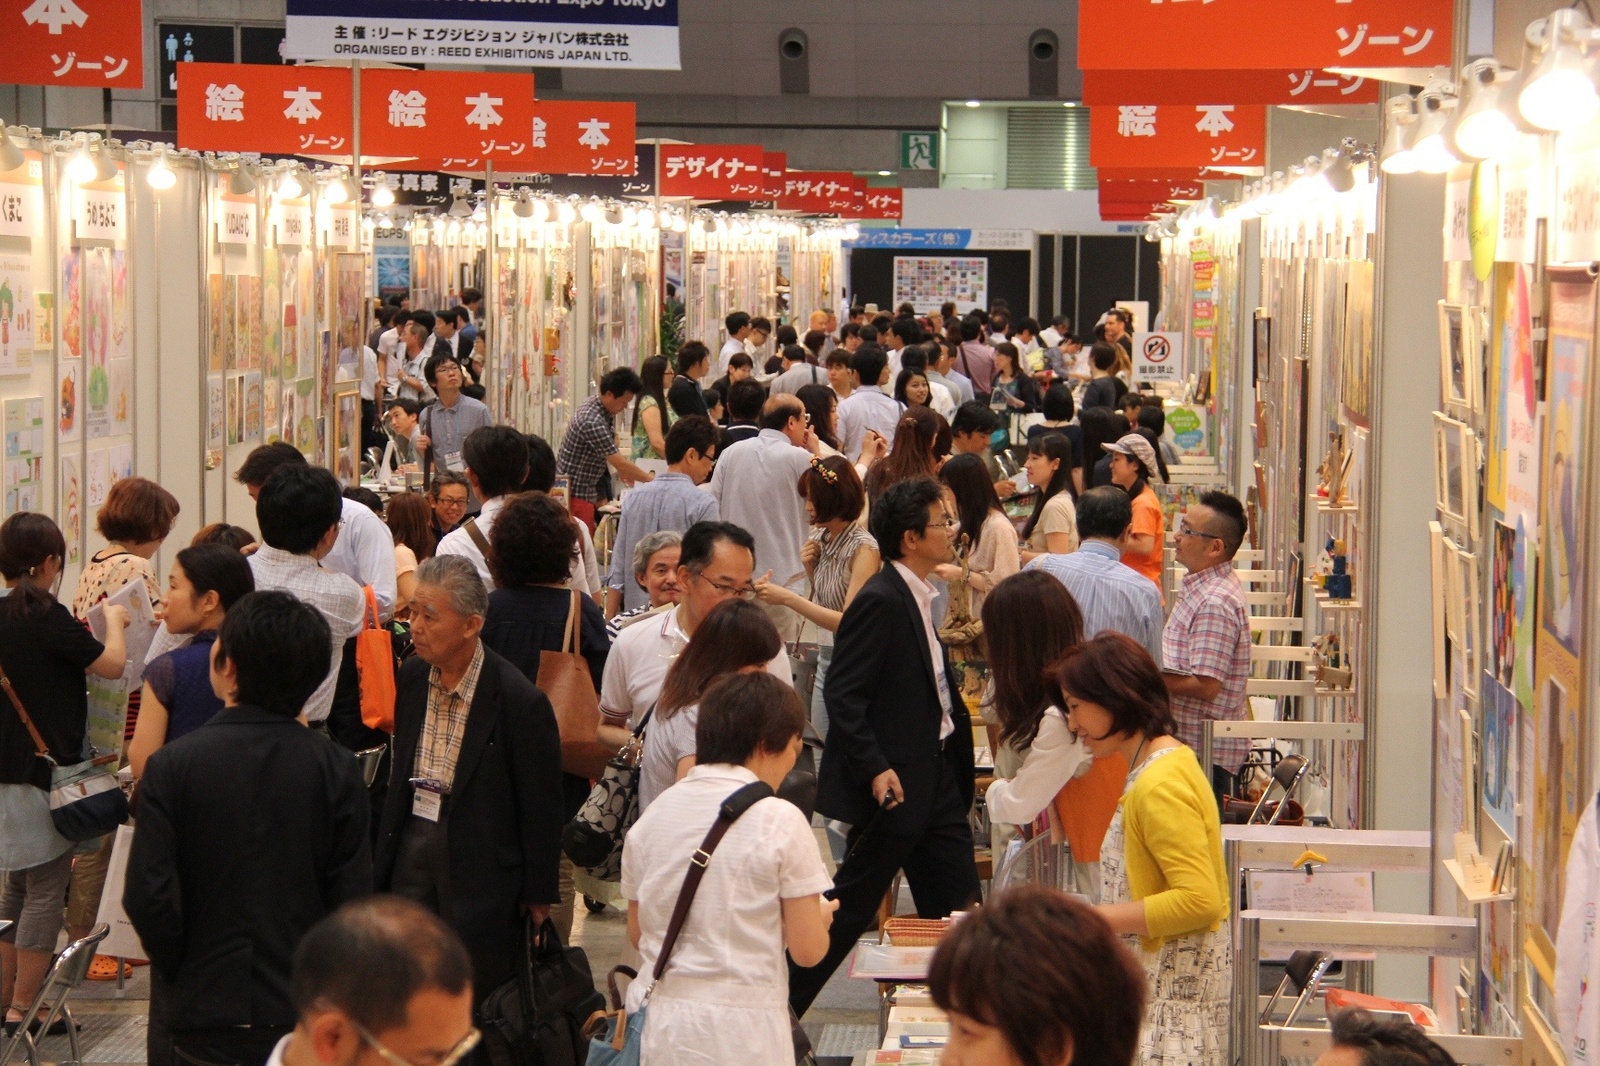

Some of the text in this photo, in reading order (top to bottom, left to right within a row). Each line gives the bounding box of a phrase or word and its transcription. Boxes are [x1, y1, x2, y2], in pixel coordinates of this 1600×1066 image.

[423, 28, 516, 43] エグジビション
[522, 31, 629, 46] ジャパン株式会社
[1336, 24, 1434, 57] ゾーン
[334, 43, 407, 56] ORGANISED
[411, 46, 427, 56] BY
[438, 47, 471, 57] REED
[475, 48, 554, 59] EXHIBITIONS
[558, 50, 601, 61] JAPAN
[605, 51, 632, 62] LTD.
[51, 51, 129, 79] ゾーン
[1288, 70, 1365, 96] ゾーン
[299, 134, 345, 150] ゾーン
[480, 139, 525, 155] ゾーン
[1211, 146, 1256, 161] ゾーン
[592, 157, 628, 170] ゾーン
[665, 156, 758, 179] デザイナー
[622, 182, 650, 192] ゾーン
[730, 184, 758, 193] ゾーン
[785, 181, 850, 197] デザイナー
[1170, 187, 1198, 197] ゾーン
[426, 194, 447, 203] ゾーン
[866, 195, 900, 208] イナー
[1139, 366, 1174, 374] 撮影禁止
